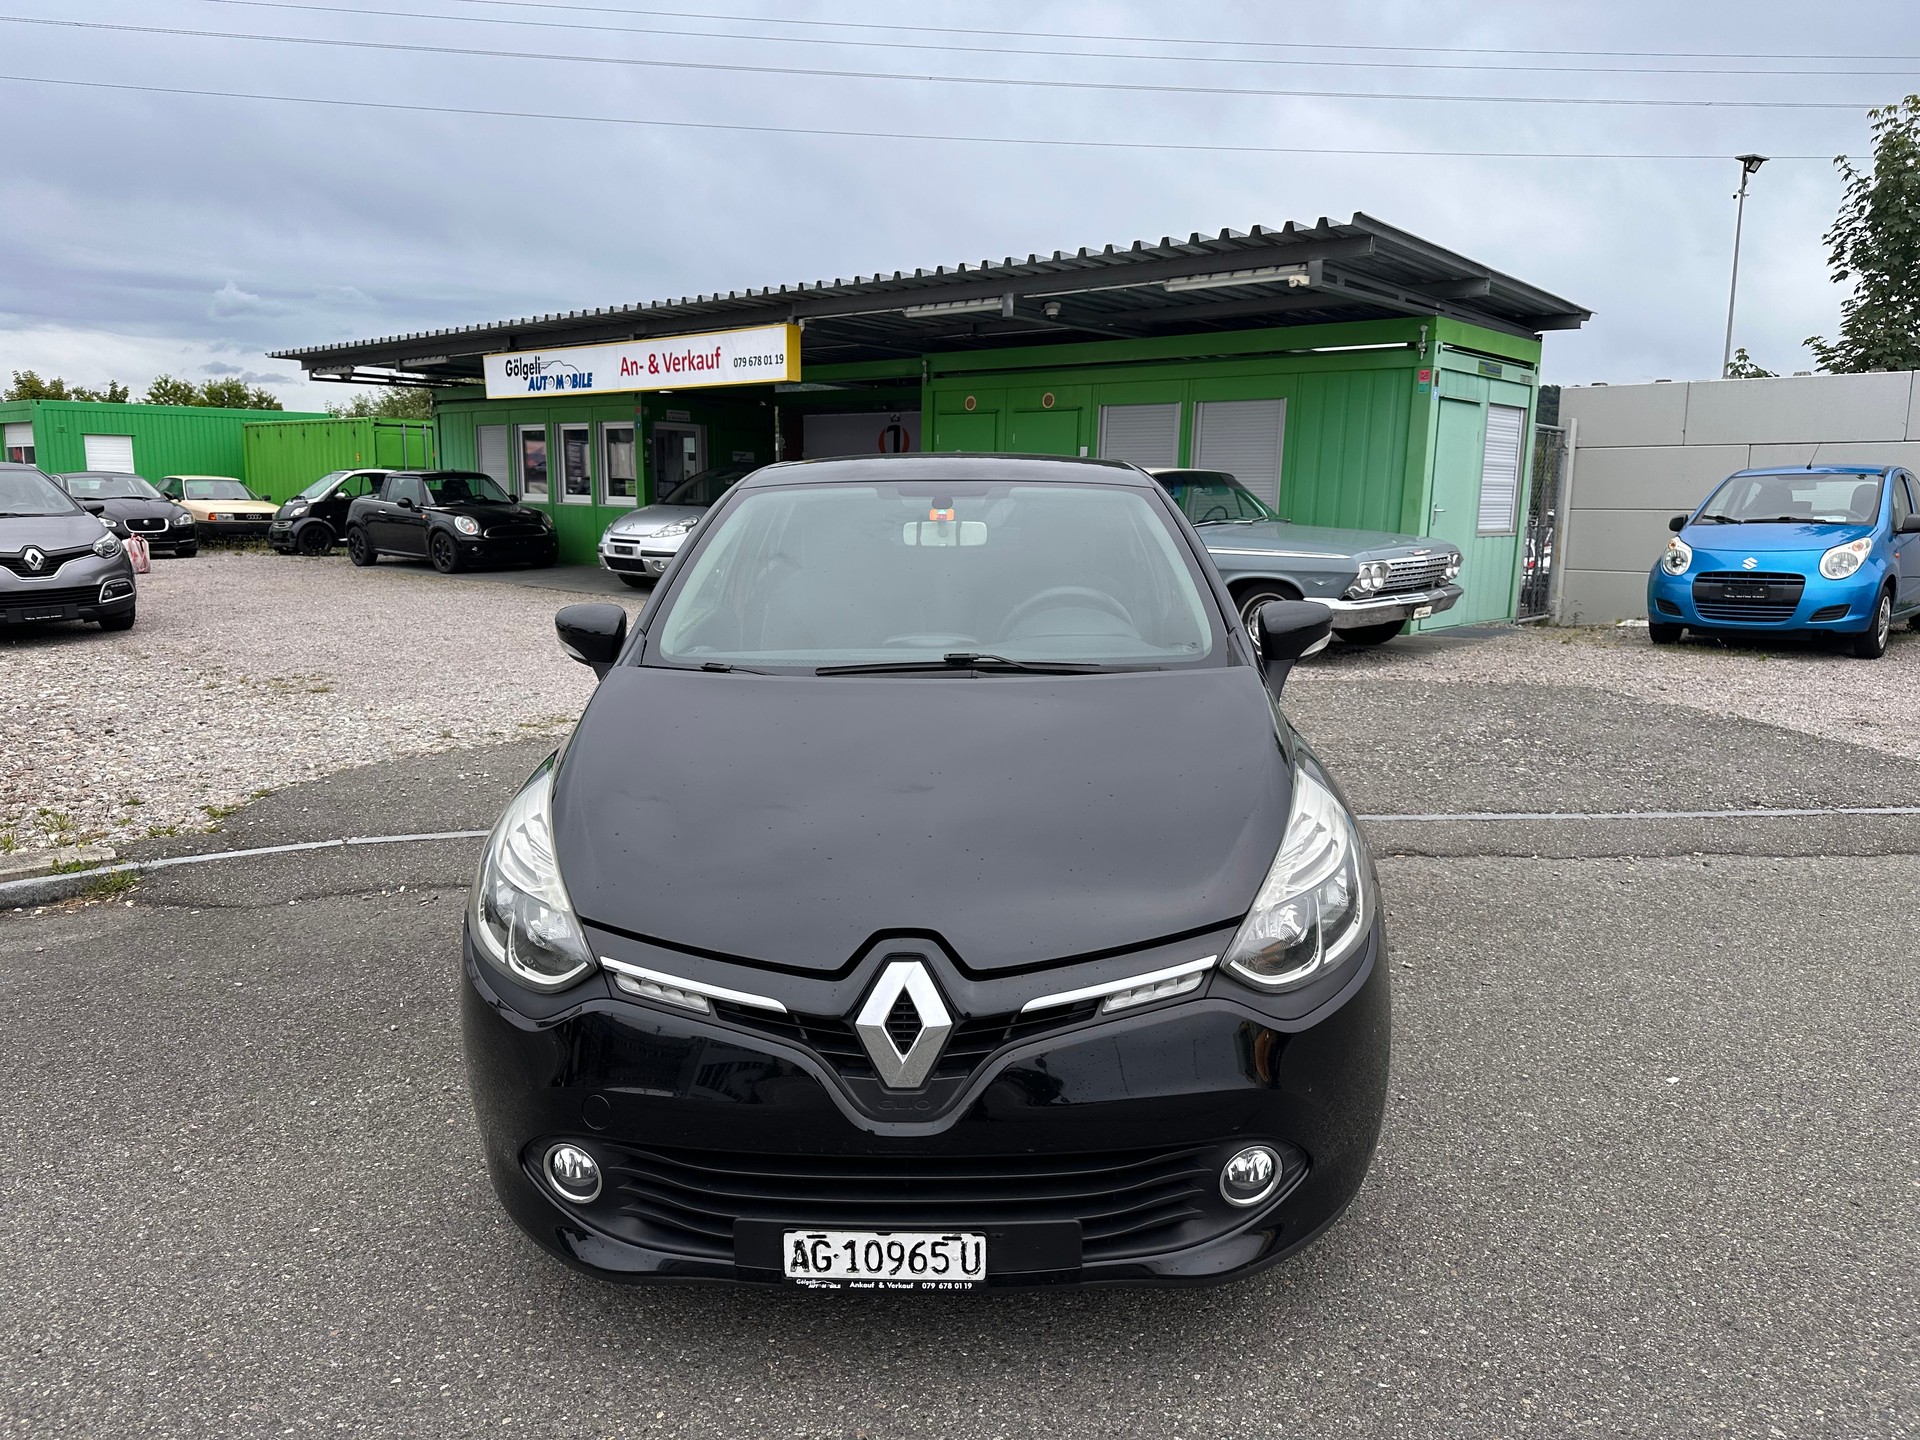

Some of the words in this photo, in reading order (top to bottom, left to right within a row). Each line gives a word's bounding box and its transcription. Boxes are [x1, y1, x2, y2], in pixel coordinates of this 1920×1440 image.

[505, 355, 541, 381] Gölgeli
[620, 356, 644, 377] An-
[648, 353, 660, 374] &
[662, 346, 721, 373] Verkauf
[733, 357, 747, 368] 079
[748, 355, 763, 367] 678
[763, 354, 773, 365] 01
[775, 353, 784, 364] 19
[528, 372, 593, 391] AUTOMOBILE
[878, 1100, 931, 1110] CLIO
[849, 1281, 875, 1289] Ankauf
[887, 1281, 914, 1289] Verkauf
